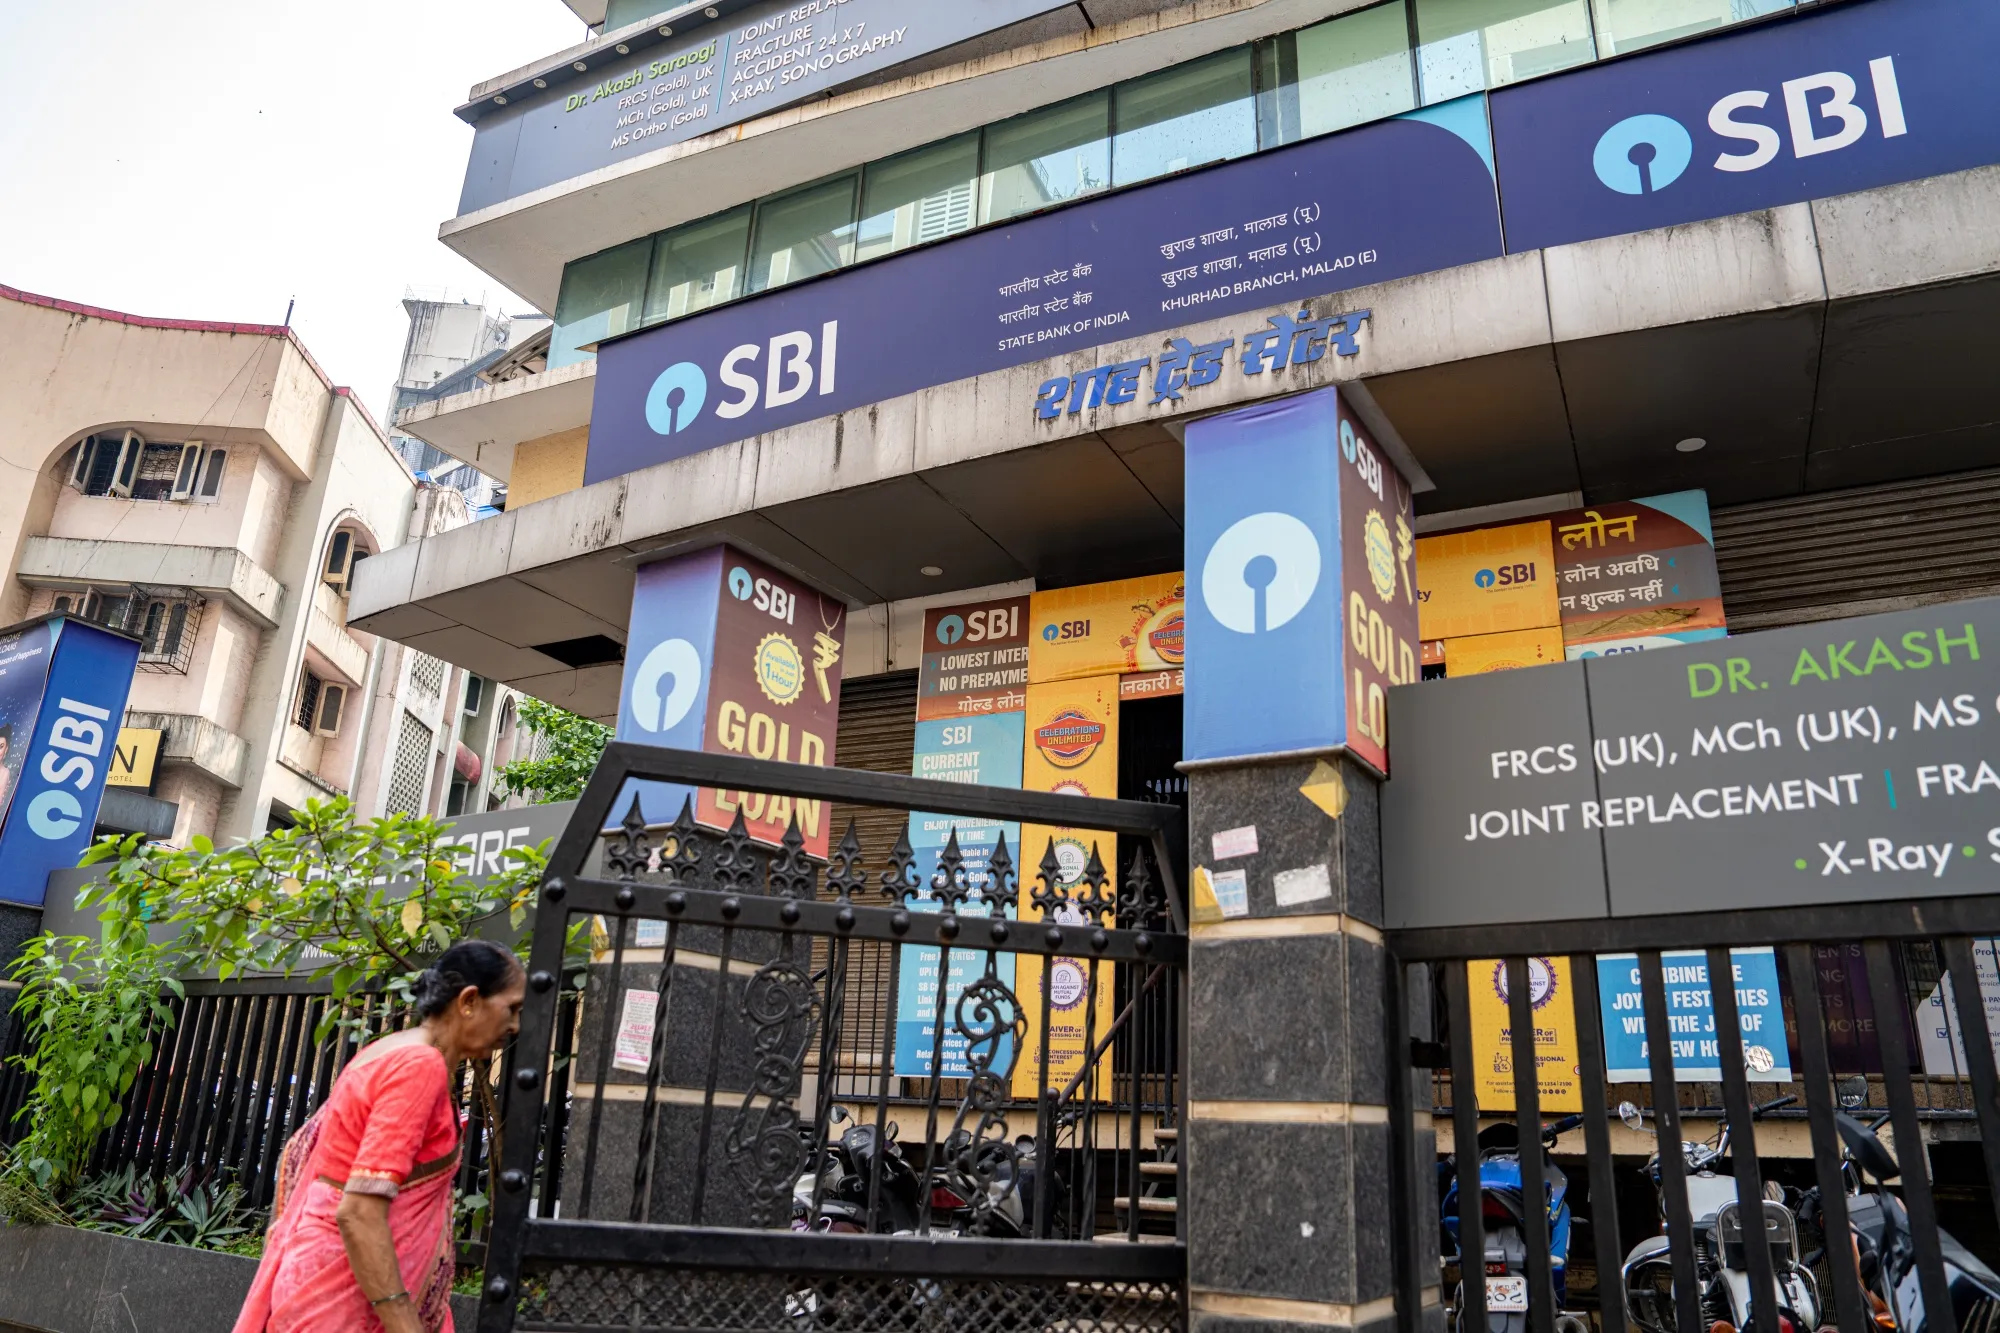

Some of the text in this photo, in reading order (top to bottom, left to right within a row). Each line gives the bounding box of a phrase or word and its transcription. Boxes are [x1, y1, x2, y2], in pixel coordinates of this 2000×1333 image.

[734, 24, 813, 66] FRACTURE
[737, 14, 786, 45] JOINT
[728, 26, 907, 106] X-RAY, SONOGRAPHY
[731, 22, 866, 86] ACCIDENT 24 X 7
[565, 38, 717, 112] Dr. Akash Saraogi
[618, 64, 715, 111] FRCS (Gold), UK
[610, 104, 708, 150] MS Ortho (Gold)
[616, 84, 711, 129] MCh (Gold), UK
[1707, 55, 1908, 172] SBI
[1160, 237, 1196, 260] खुराड
[1200, 227, 1239, 246] शाखा,
[1244, 213, 1288, 234] मालाड
[999, 277, 1040, 297] भारतीय
[1043, 269, 1068, 286] स्टेट
[1161, 265, 1198, 288] खुराड
[1202, 255, 1243, 275] शाखा,
[1247, 243, 1288, 263] मलाड
[1161, 249, 1377, 312] KHURHAD BRANCH, MALAD (E)
[999, 304, 1041, 325] भारतीय
[1043, 296, 1069, 314] स्टेट
[999, 310, 1130, 351] STATE BANK OF INDIA
[715, 320, 838, 419] SBI
[1034, 357, 1150, 419] शाह
[1356, 437, 1383, 501] SBI
[1558, 510, 1637, 551] लोन
[1497, 562, 1536, 586] SBI
[1564, 554, 1660, 583] लोन अवधि
[752, 577, 796, 625] SBI
[1580, 588, 1625, 612] शुल्क
[1629, 578, 1663, 602] नहीं
[966, 606, 1019, 642] SBI
[1060, 619, 1090, 640] SBI
[1350, 591, 1415, 685] GOLD
[940, 651, 990, 671] LOWEST
[1688, 623, 1980, 698] DR. AKASH
[940, 676, 957, 692] NO
[958, 690, 1026, 713] गोल्ड लोन
[1353, 667, 1387, 750] LO
[40, 697, 111, 791] SBI
[717, 700, 825, 767] GOLD
[942, 725, 972, 746] SBI
[1039, 725, 1100, 737] CELEBRATIONS
[1047, 734, 1092, 745] UNLIMITED
[1491, 694, 1980, 779] FRCS (UK), MCh (UK), MS
[922, 751, 980, 771] CURRENT
[924, 820, 949, 831] ENJOY
[1464, 803, 1570, 841] JOINT
[1581, 773, 1862, 829] REPLACEMENT
[967, 830, 985, 841] TIME
[1818, 837, 1953, 878] X-Ray
[919, 967, 931, 976] UPI
[1668, 1015, 1699, 1033] THE
[1741, 1013, 1762, 1031] OF
[1671, 1040, 1695, 1058] EW
